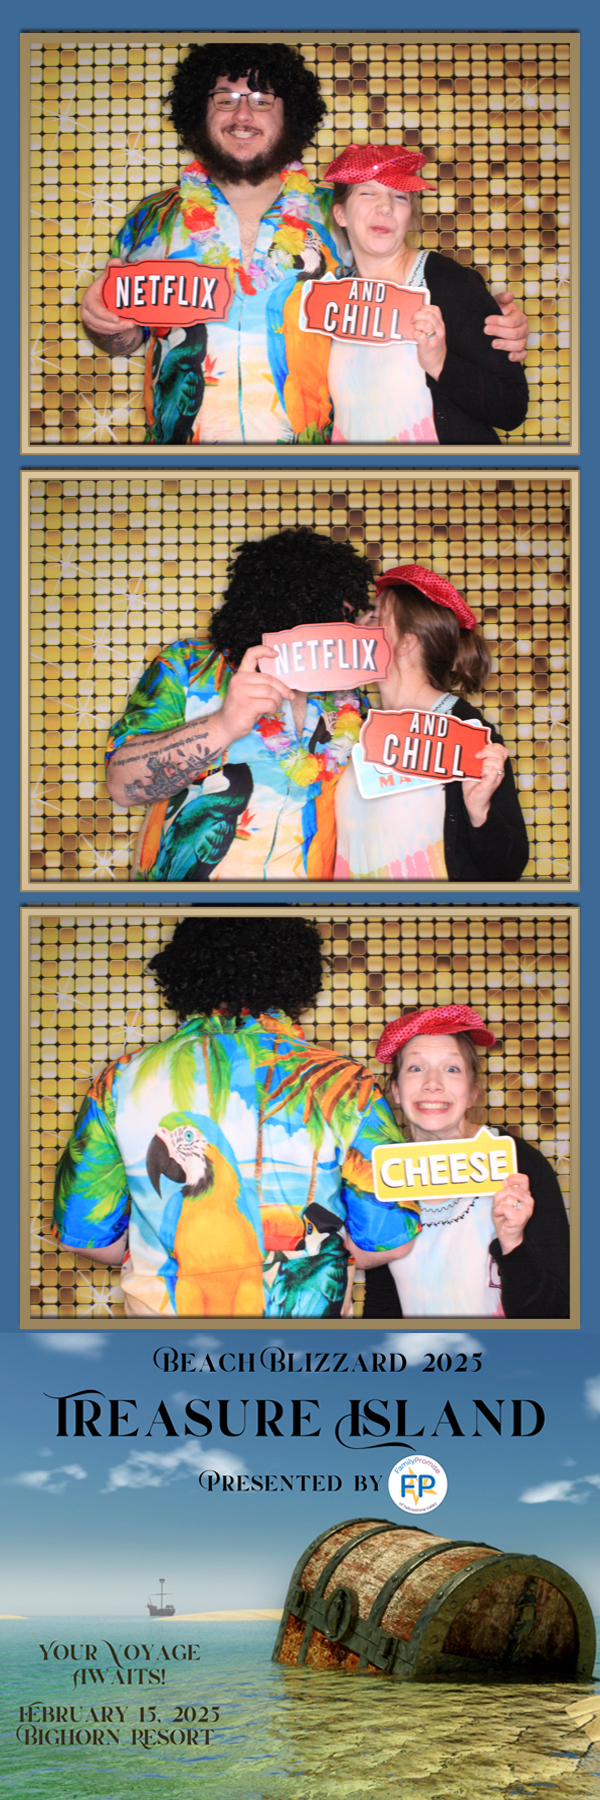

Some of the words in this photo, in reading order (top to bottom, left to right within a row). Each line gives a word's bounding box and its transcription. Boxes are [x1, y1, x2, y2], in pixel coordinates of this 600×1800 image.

[115, 274, 219, 311] NETFLIX
[348, 281, 386, 303] AND
[323, 301, 404, 340] CHILL
[272, 637, 378, 676] NETFLIX
[409, 712, 449, 738] AND
[382, 733, 466, 777] CHILL
[380, 1150, 509, 1188] CHEESE
